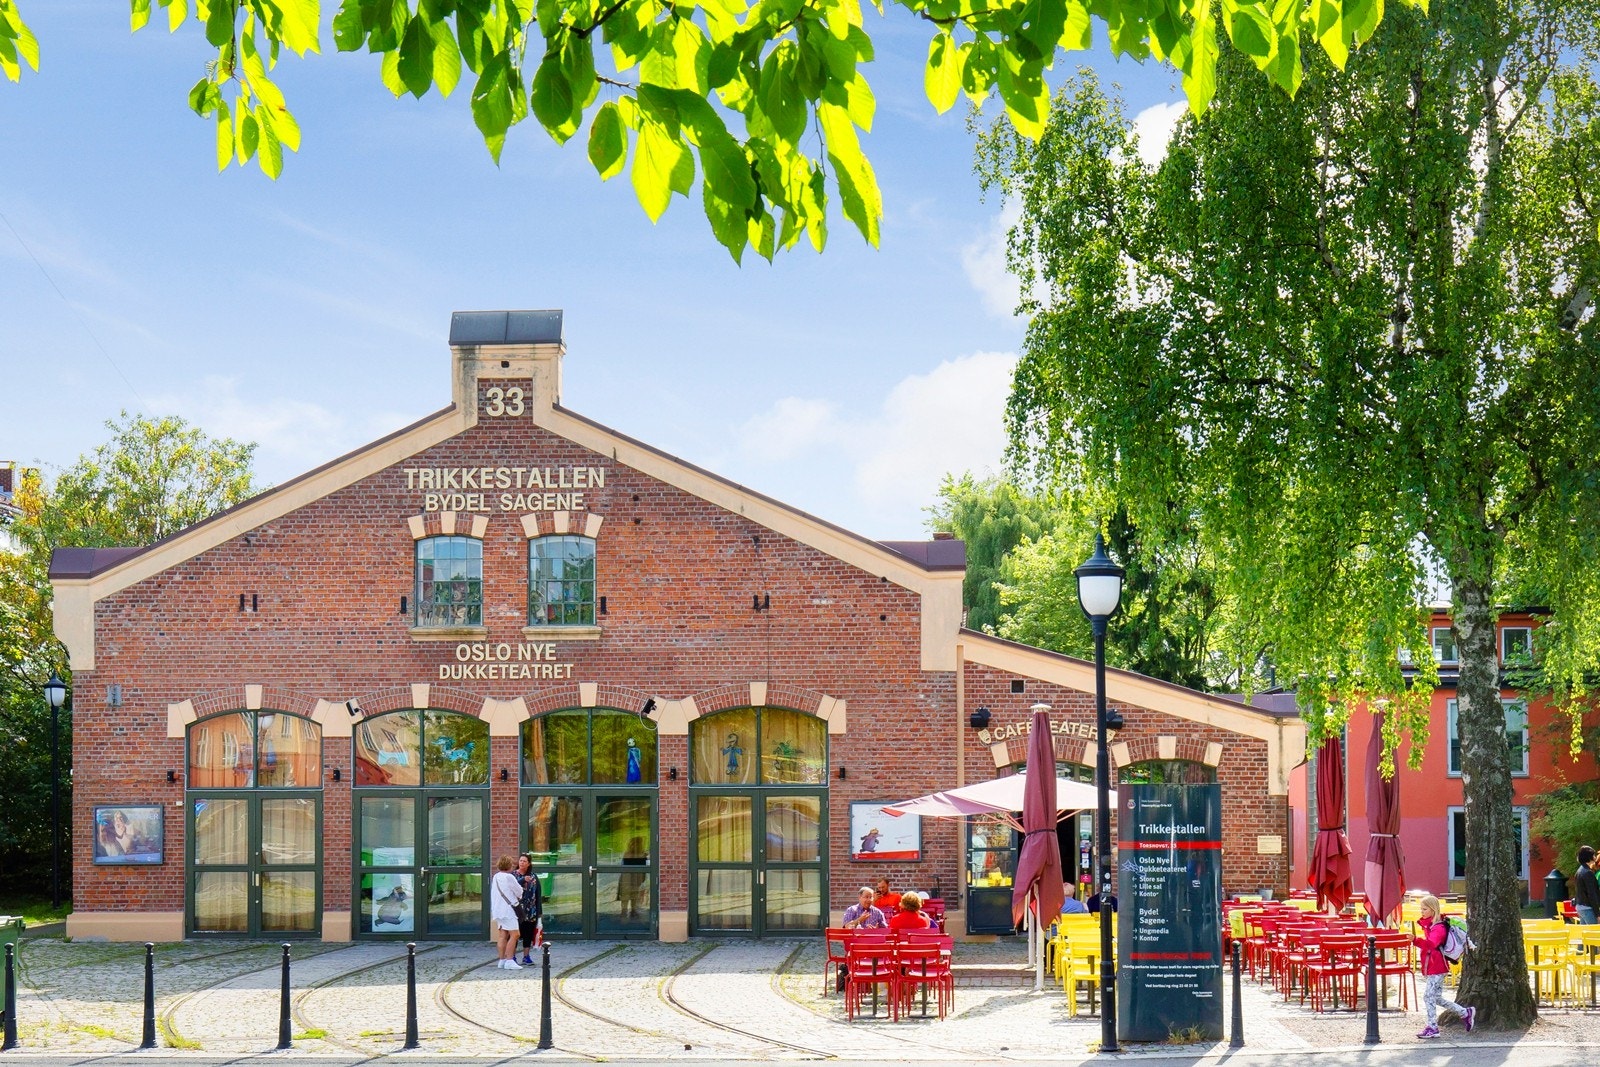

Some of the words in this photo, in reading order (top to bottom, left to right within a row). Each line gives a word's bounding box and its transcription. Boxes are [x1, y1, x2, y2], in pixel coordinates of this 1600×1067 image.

[485, 387, 525, 417] 33
[403, 467, 605, 490] TRIKKESTALLEN
[425, 493, 491, 512] BYDEL
[500, 492, 584, 511] SAGENE
[455, 643, 511, 662] OSLO
[518, 643, 557, 661] NYE
[439, 664, 574, 680] DUKKETEATRET
[1139, 824, 1205, 834] Trikkestallen
[1157, 857, 1170, 865] Nye
[1139, 908, 1159, 916] Bydel
